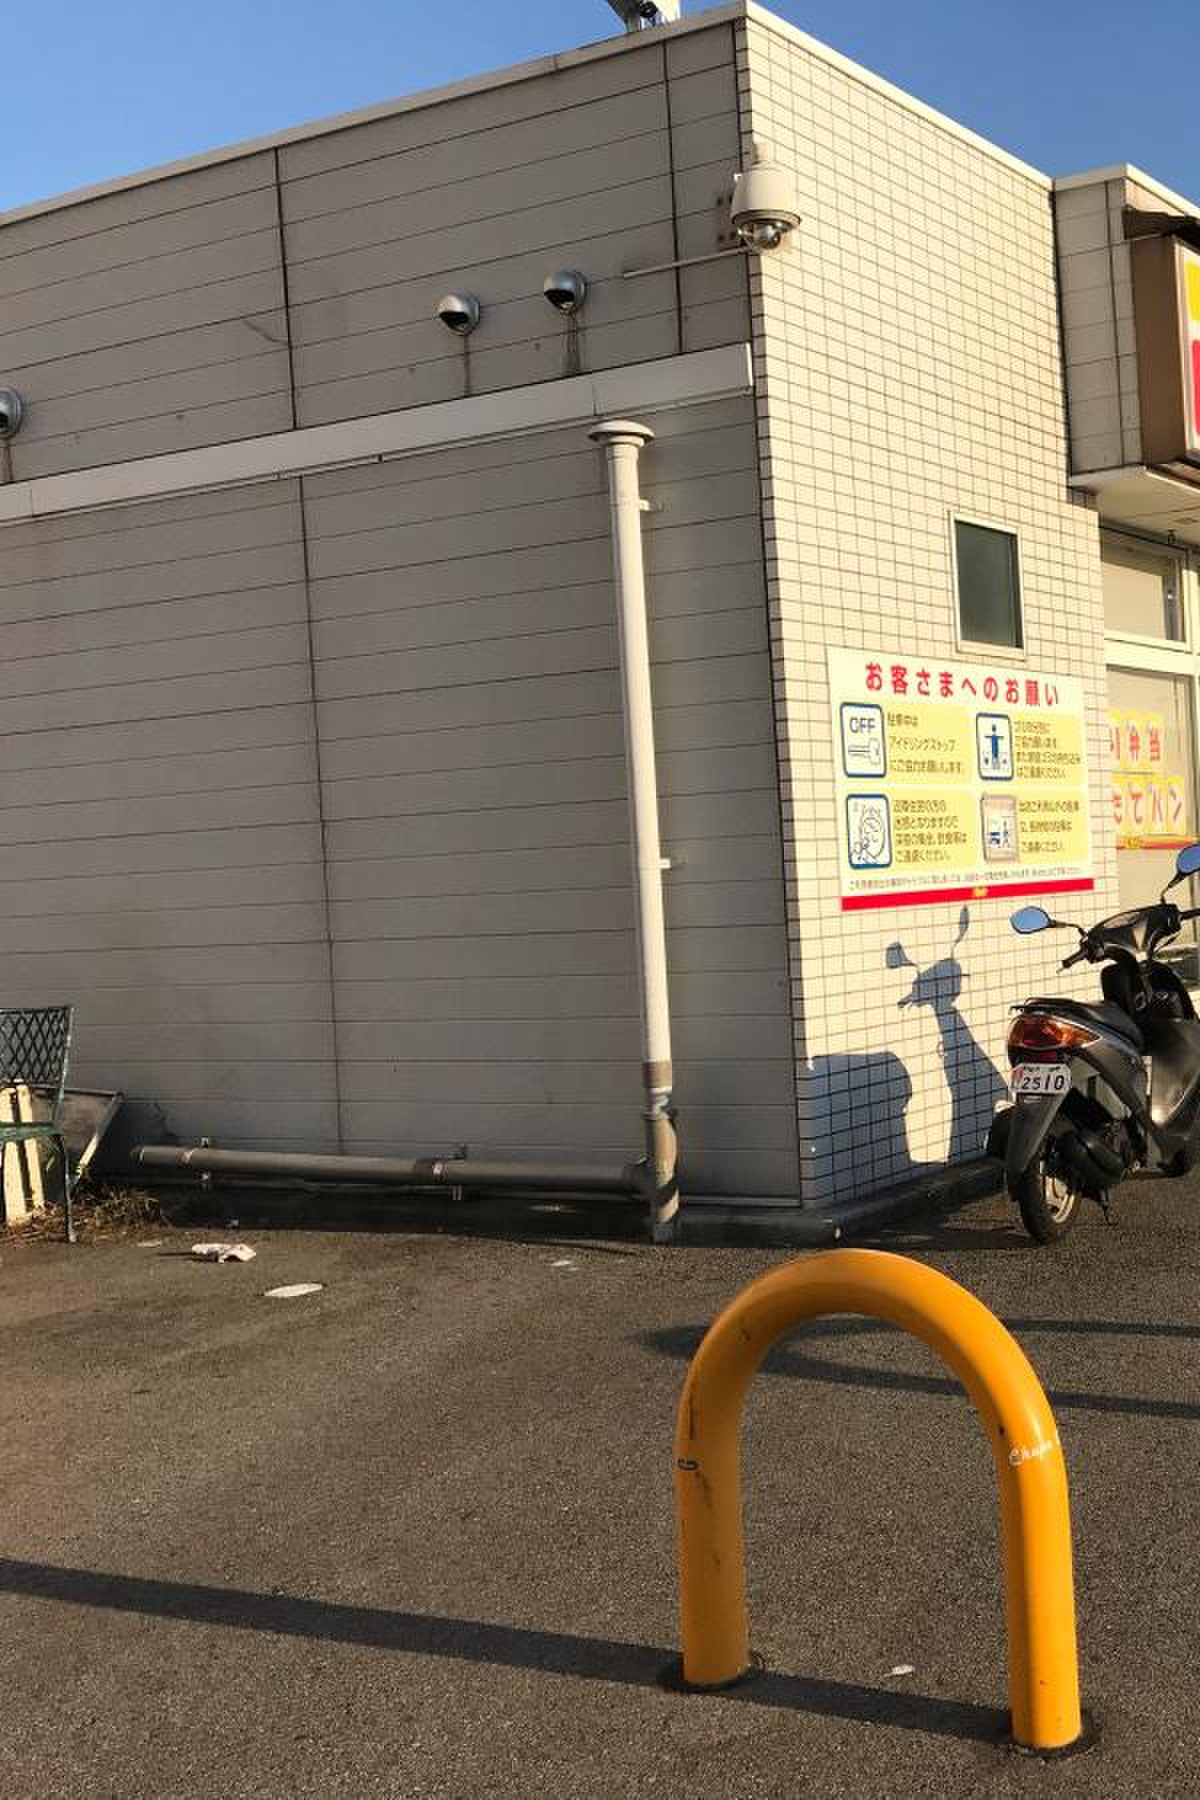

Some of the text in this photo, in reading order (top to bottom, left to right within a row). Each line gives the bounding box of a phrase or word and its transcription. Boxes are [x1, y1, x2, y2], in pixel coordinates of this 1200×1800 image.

[864, 662, 1059, 706] お客さまへのお願い
[850, 716, 876, 735] OFF
